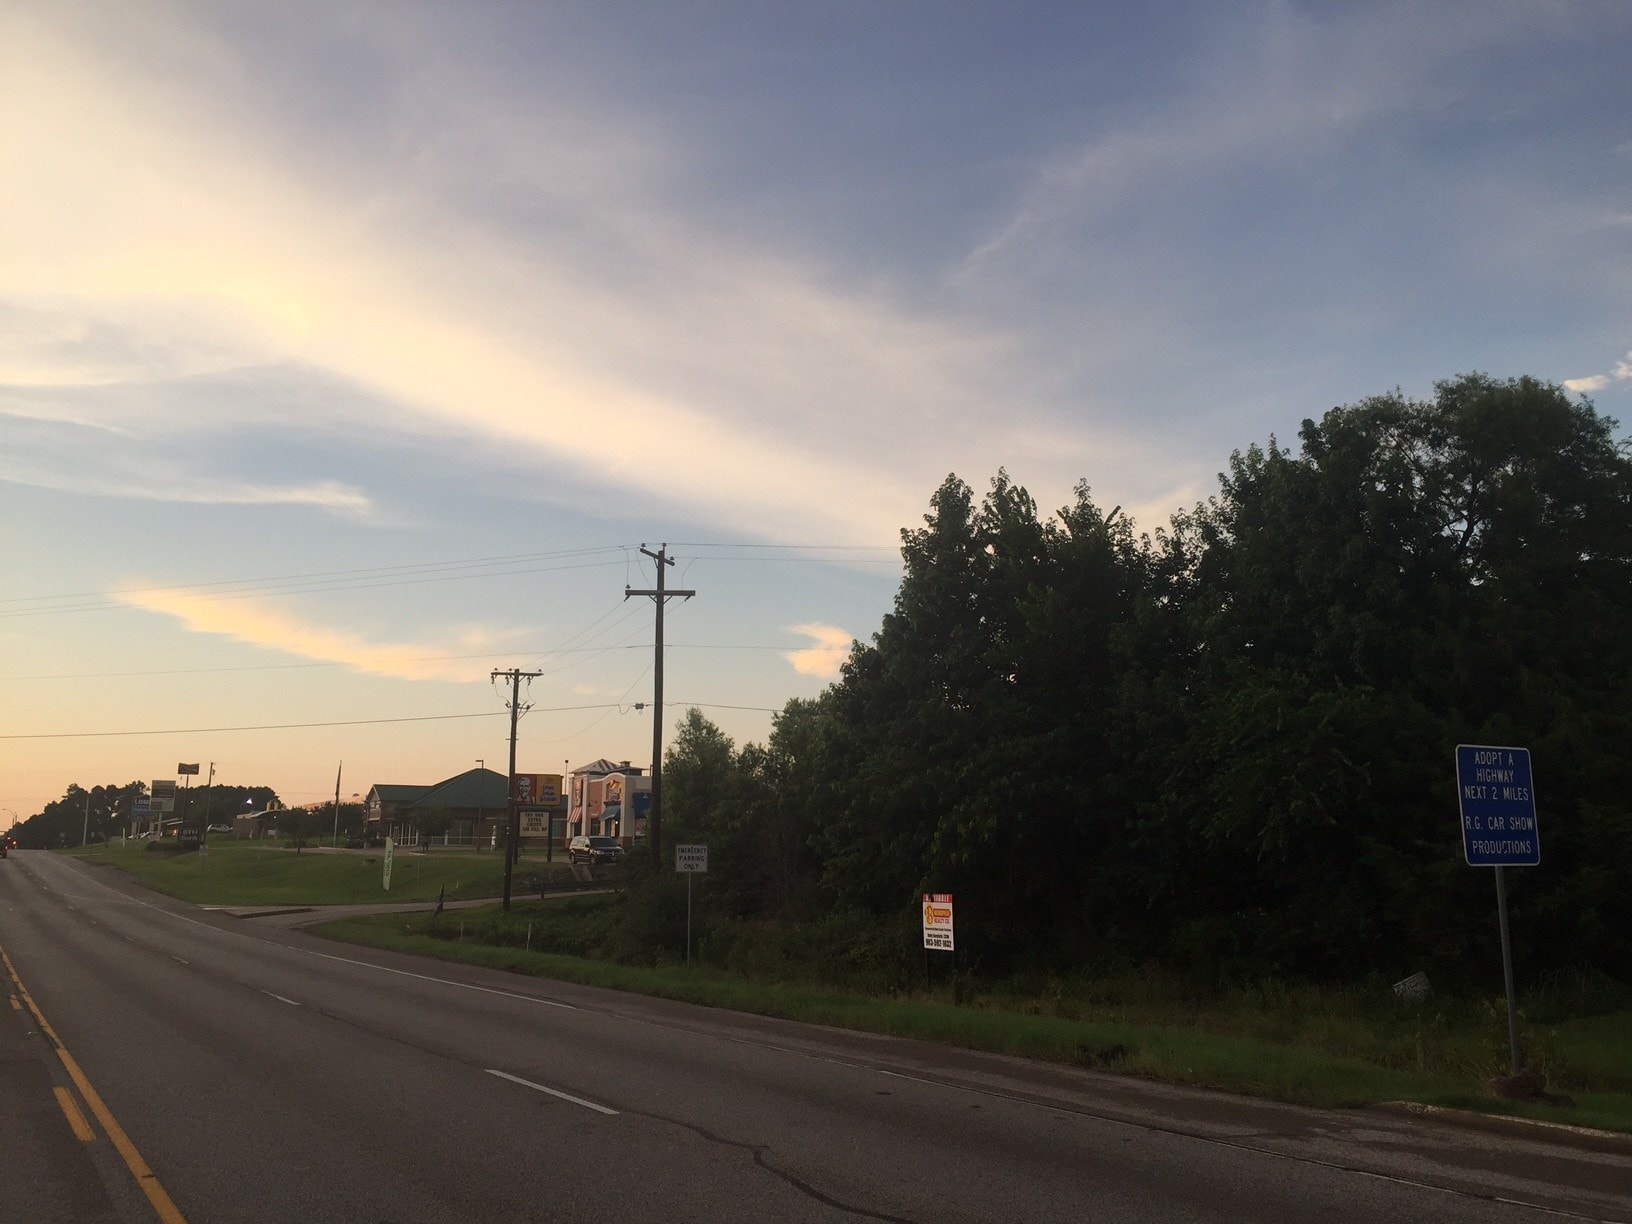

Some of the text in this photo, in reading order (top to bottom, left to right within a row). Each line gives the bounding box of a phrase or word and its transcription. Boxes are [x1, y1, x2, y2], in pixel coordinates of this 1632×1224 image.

[1474, 751, 1514, 766] ADOPT A
[1476, 768, 1514, 783] HIGHWAY
[1464, 785, 1529, 801] NEXT 2 MILES
[1465, 815, 1533, 831] R.G. CAR SHOW
[1472, 839, 1532, 855] PRODUCTIONS
